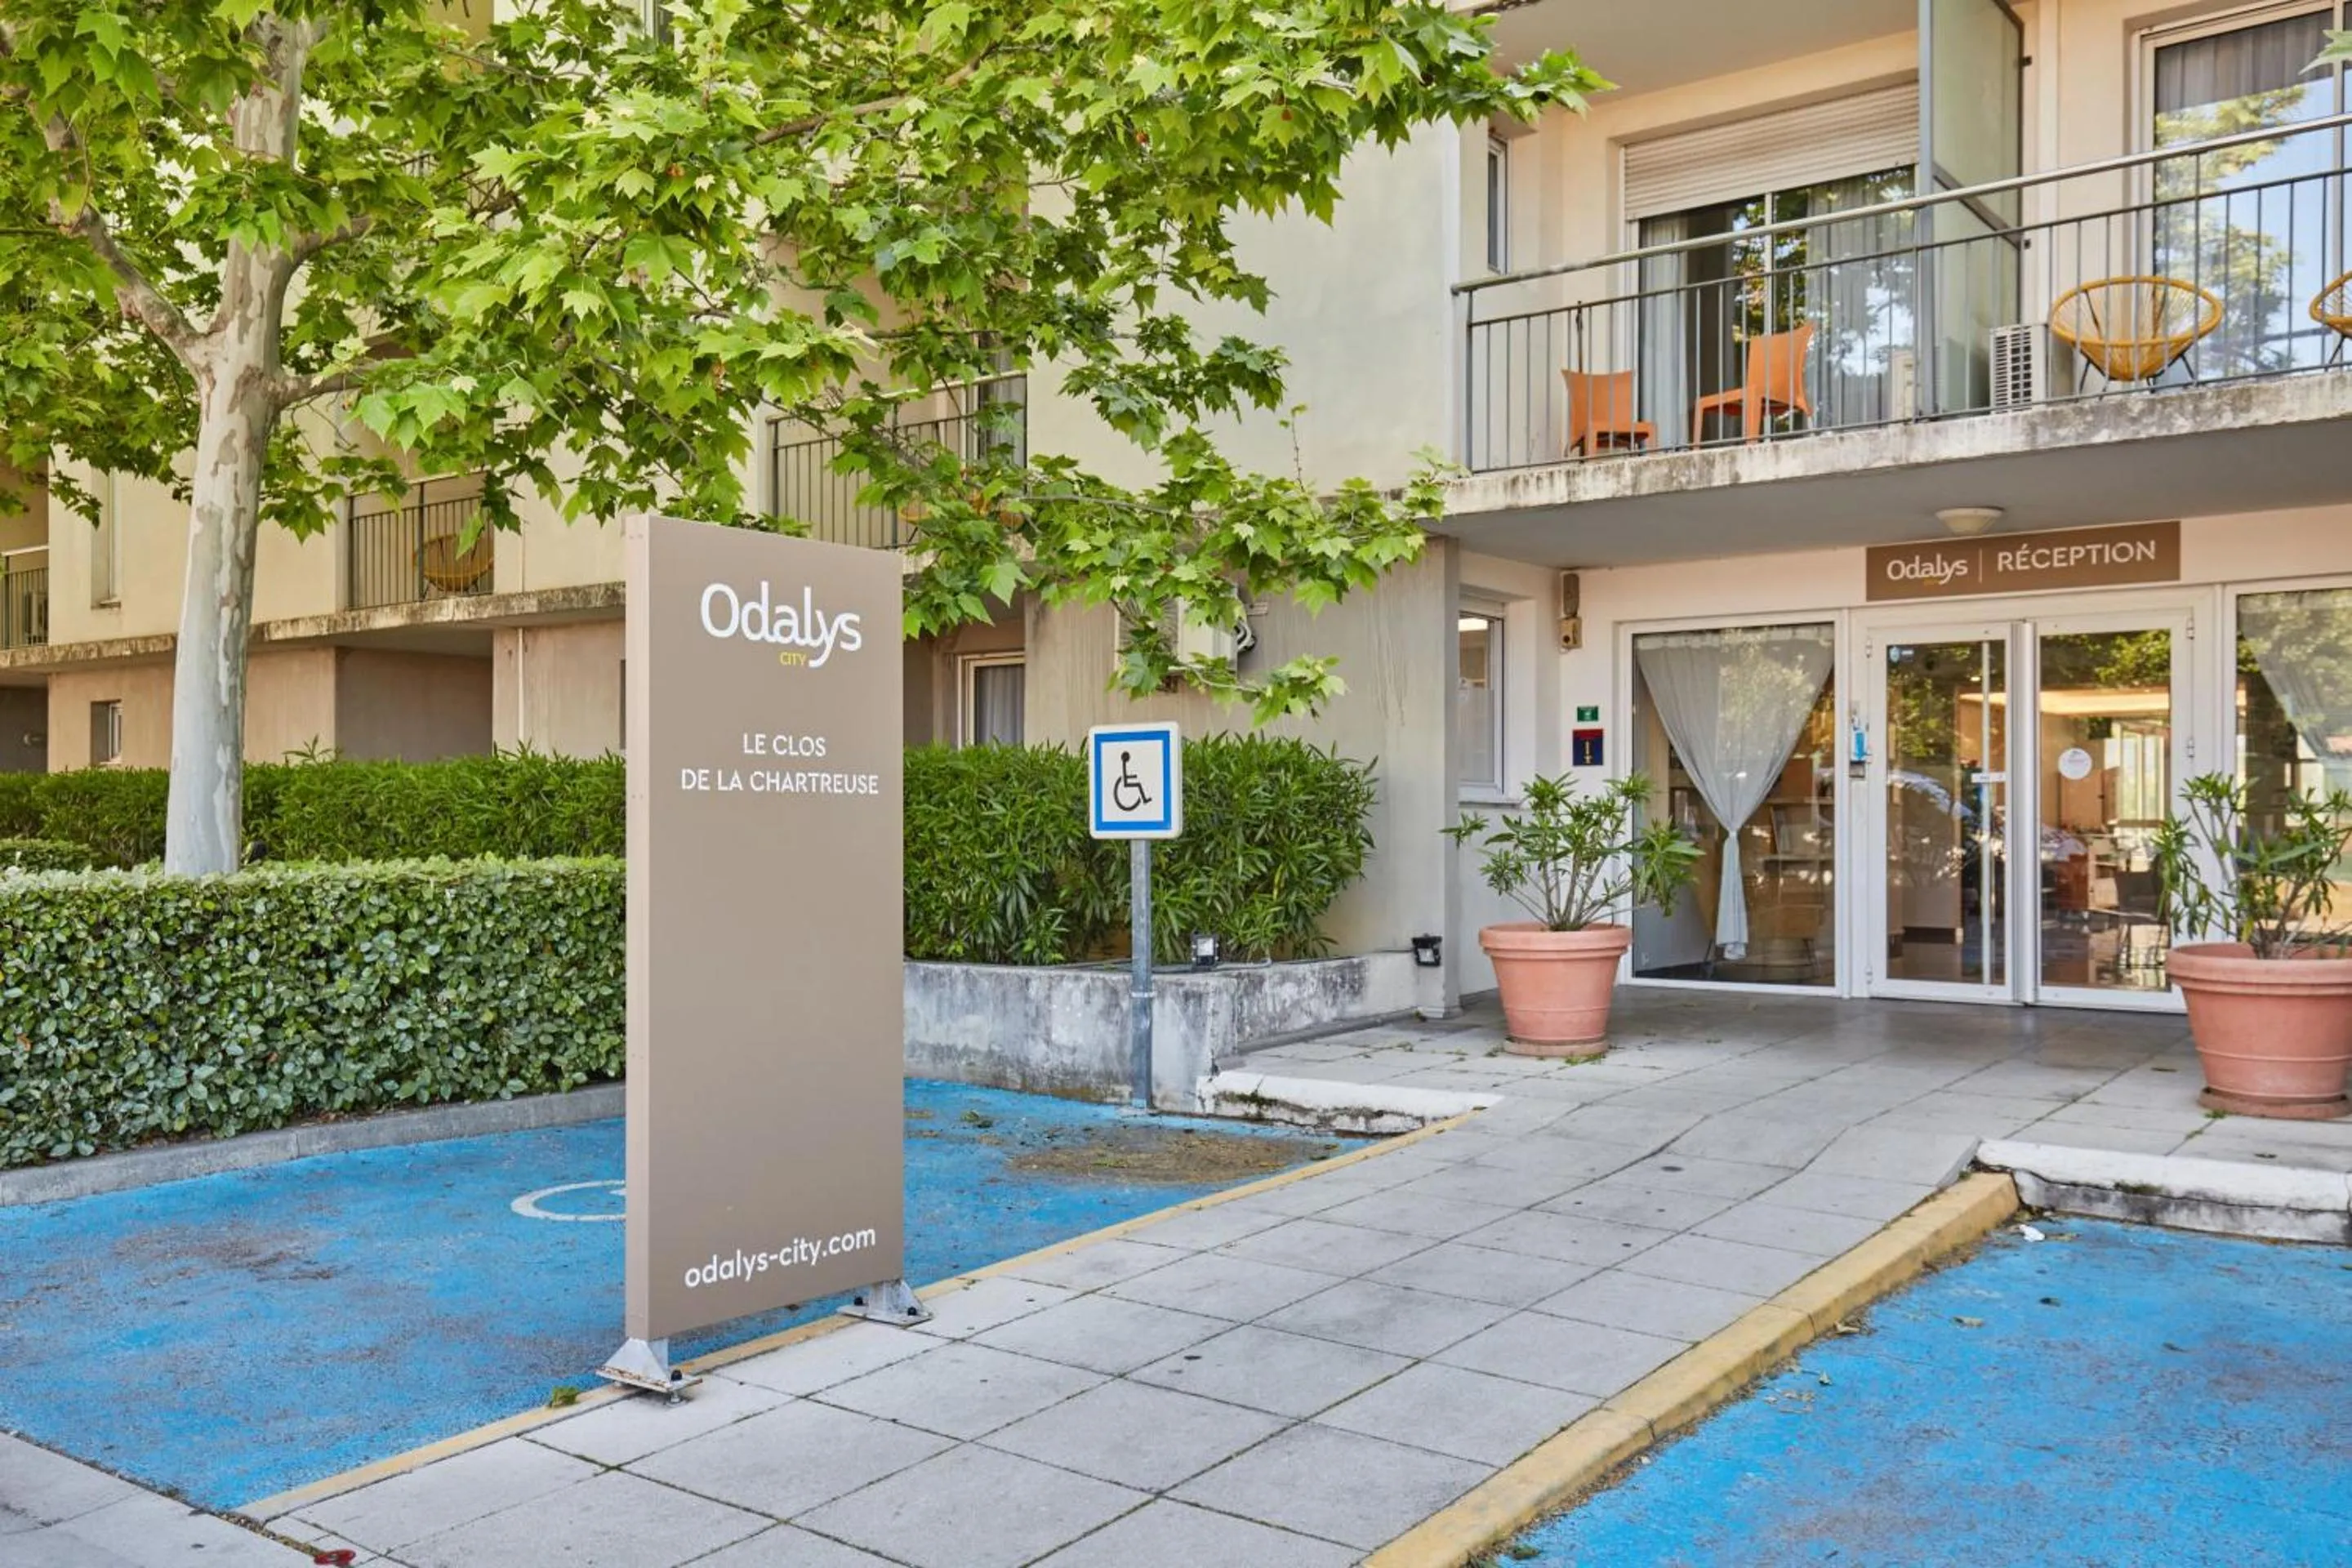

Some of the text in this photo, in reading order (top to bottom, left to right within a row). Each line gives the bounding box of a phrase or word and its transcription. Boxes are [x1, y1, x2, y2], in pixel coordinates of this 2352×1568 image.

[1886, 539, 2156, 586] Odalys RÉCEPTION
[700, 580, 862, 668] Odalys
[780, 652, 806, 666] CITY
[743, 733, 826, 757] LE CLOS
[681, 768, 879, 795] DE LA CHARTREUSE
[684, 1228, 876, 1288] odalys-city.com
